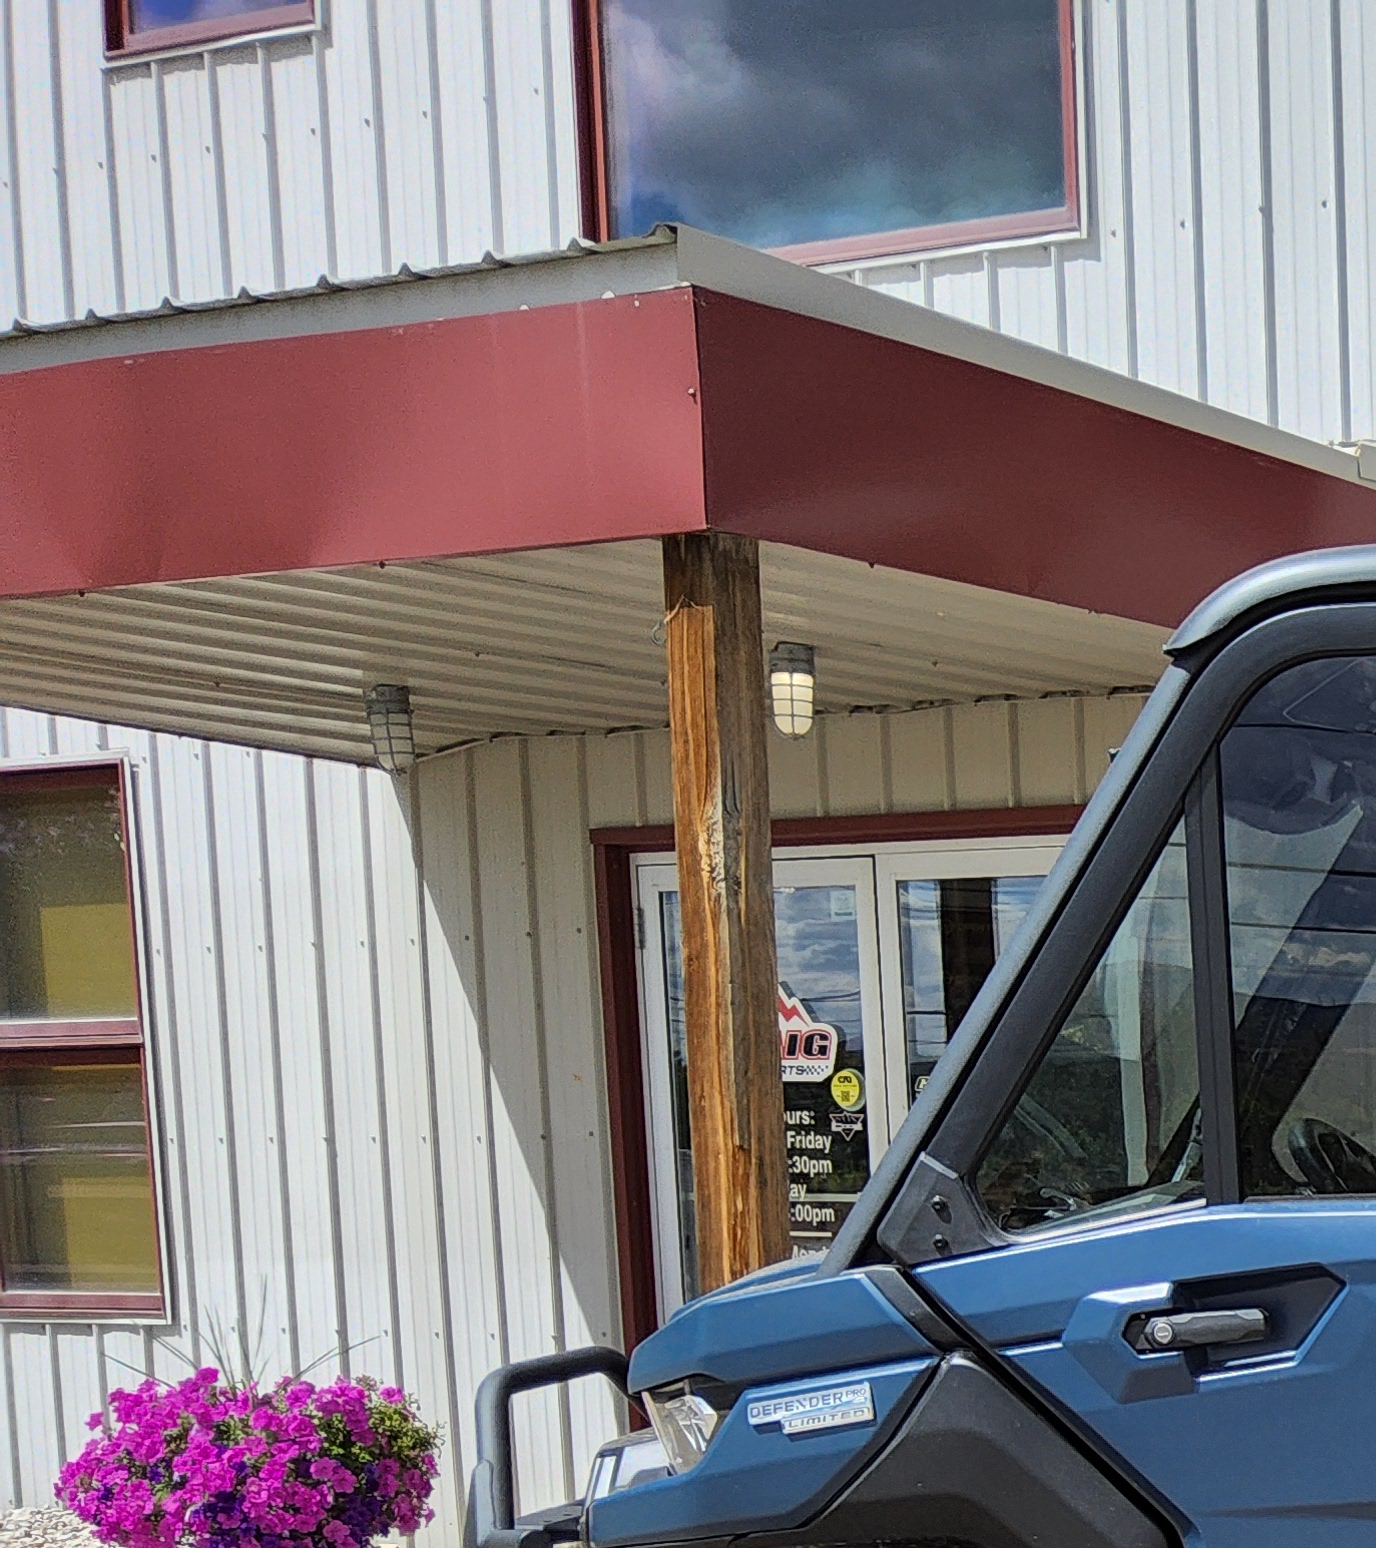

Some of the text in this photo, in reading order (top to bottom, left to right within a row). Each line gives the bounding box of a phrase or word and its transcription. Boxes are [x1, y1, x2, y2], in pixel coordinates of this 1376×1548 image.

[782, 1029, 832, 1060] IG
[783, 1110, 816, 1125] urs:
[786, 1131, 832, 1153] Friday
[788, 1183, 807, 1199] ay
[790, 1204, 835, 1226] :00pm
[750, 1387, 867, 1419] DEFENDER PRO
[787, 1409, 866, 1428] LIMITED
